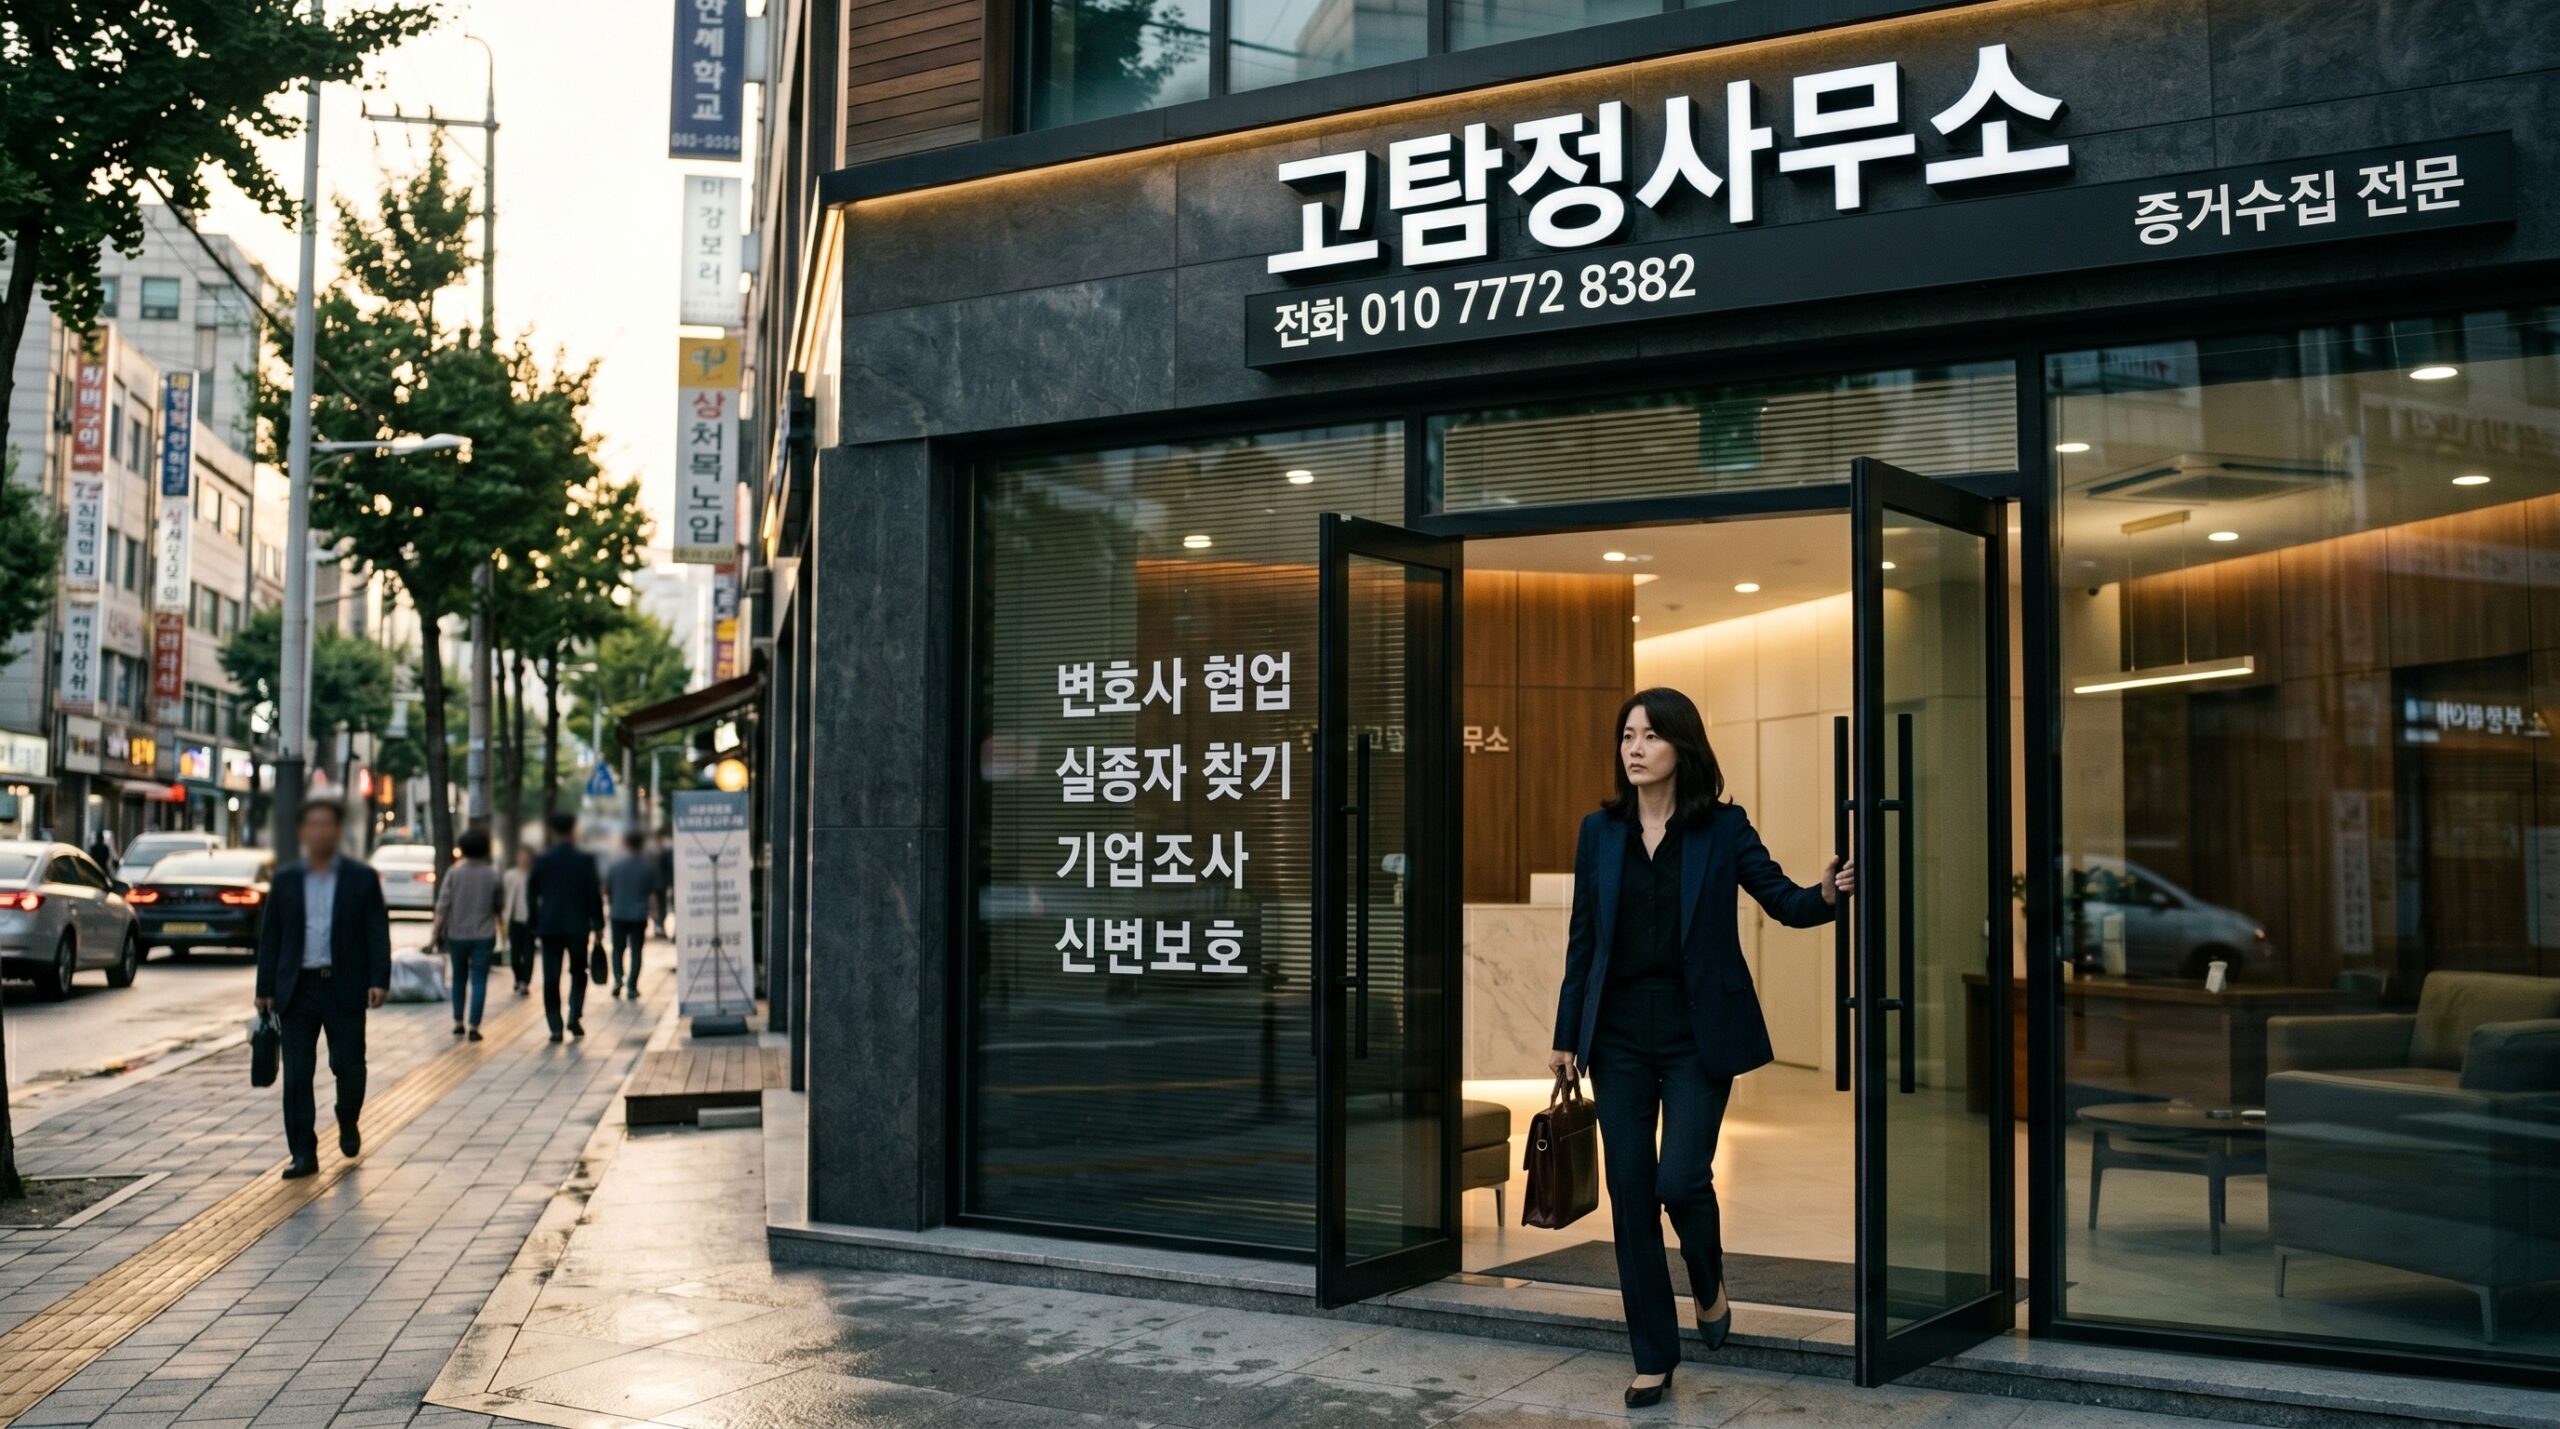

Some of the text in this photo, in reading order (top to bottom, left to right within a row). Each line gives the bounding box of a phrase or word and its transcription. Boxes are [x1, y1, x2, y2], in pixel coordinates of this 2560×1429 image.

[1267, 43, 2070, 275] 고탐정사무소
[2134, 154, 2465, 246] 증거수집 전문
[1273, 252, 1697, 349] 전화 010 7772 8382
[1058, 651, 1291, 718] 변호사 협업
[1055, 741, 1291, 803] 실종자 찾기
[1056, 831, 1249, 889] 기업조사
[1054, 917, 1249, 975] 신변보호
